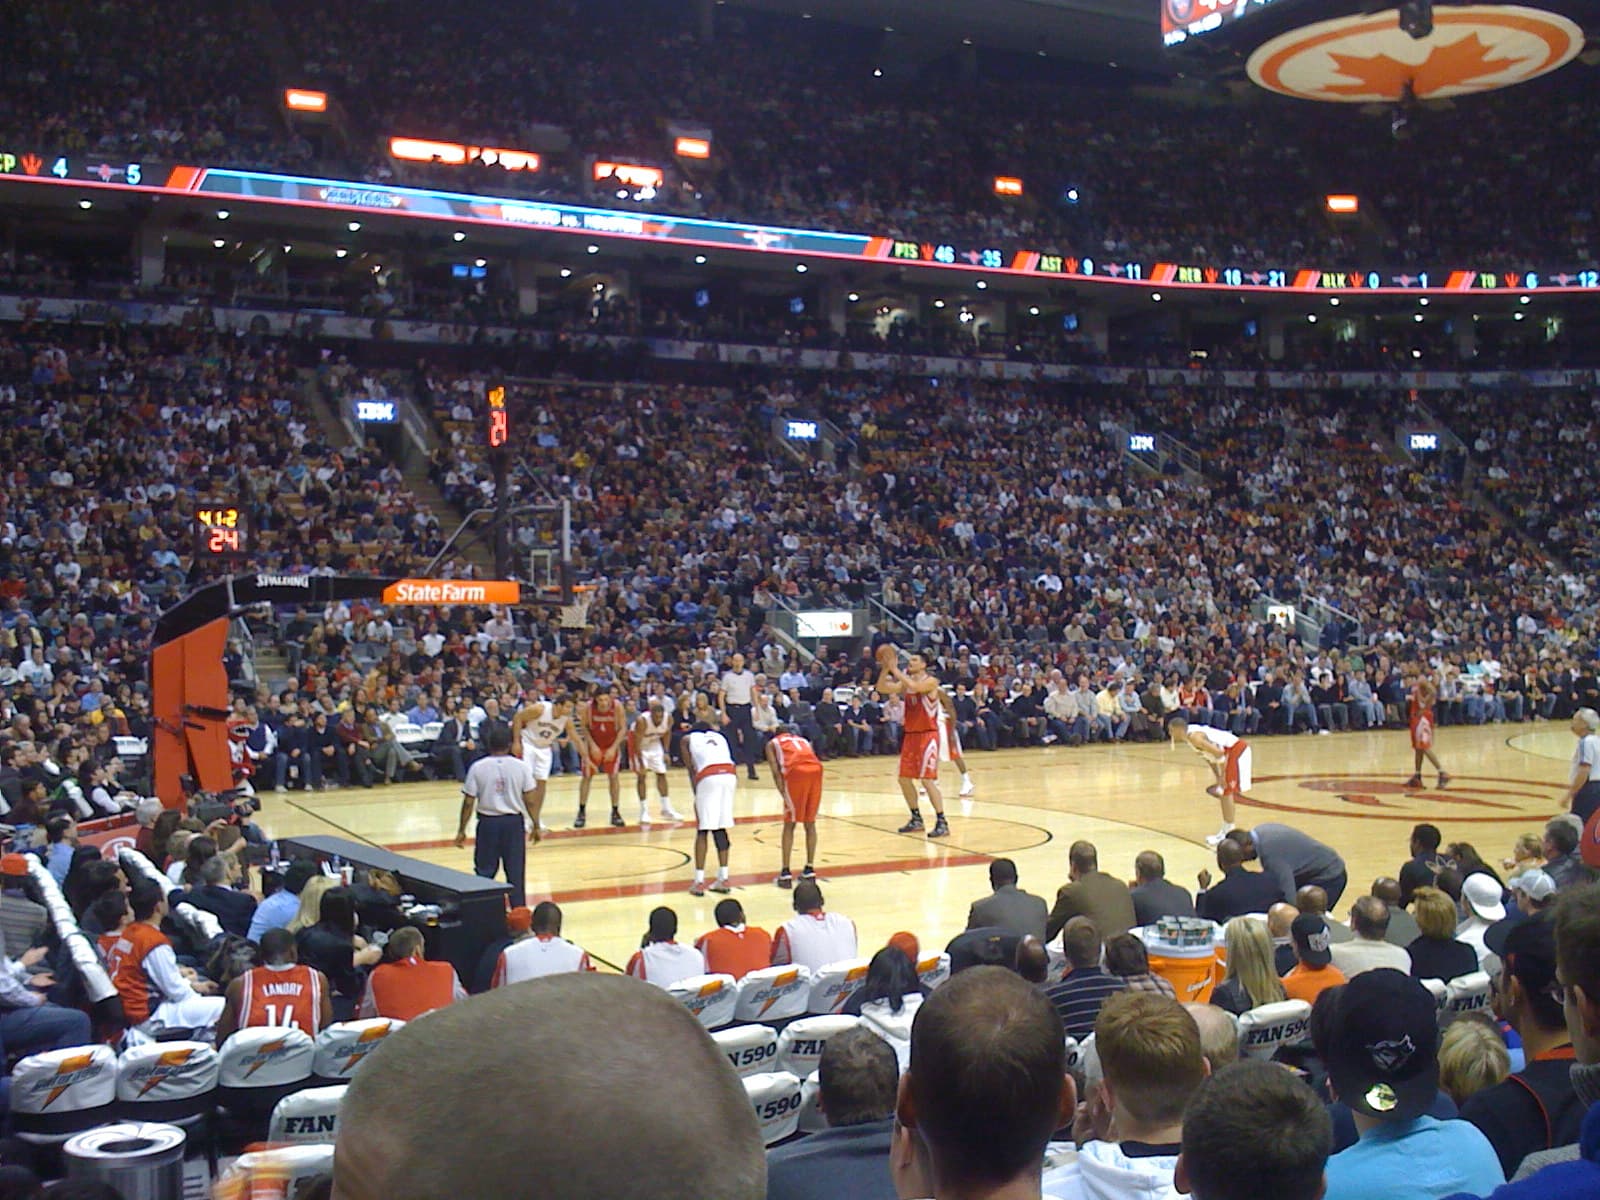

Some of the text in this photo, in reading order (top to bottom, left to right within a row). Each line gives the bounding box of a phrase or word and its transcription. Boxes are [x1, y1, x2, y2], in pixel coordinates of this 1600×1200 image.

[53, 157, 69, 178] 4
[127, 163, 142, 185] 5
[983, 249, 1002, 267] 35
[1040, 255, 1063, 273] AST
[1126, 263, 1141, 280] 11
[1268, 270, 1285, 288] 21
[1368, 271, 1380, 289] 0
[1418, 272, 1428, 289] 1
[1577, 271, 1599, 288] 12
[209, 528, 239, 553] 24
[256, 574, 309, 588] SPALDING
[262, 982, 303, 997] LANDRY
[264, 1004, 299, 1031] 14
[284, 1114, 337, 1134] FAN
